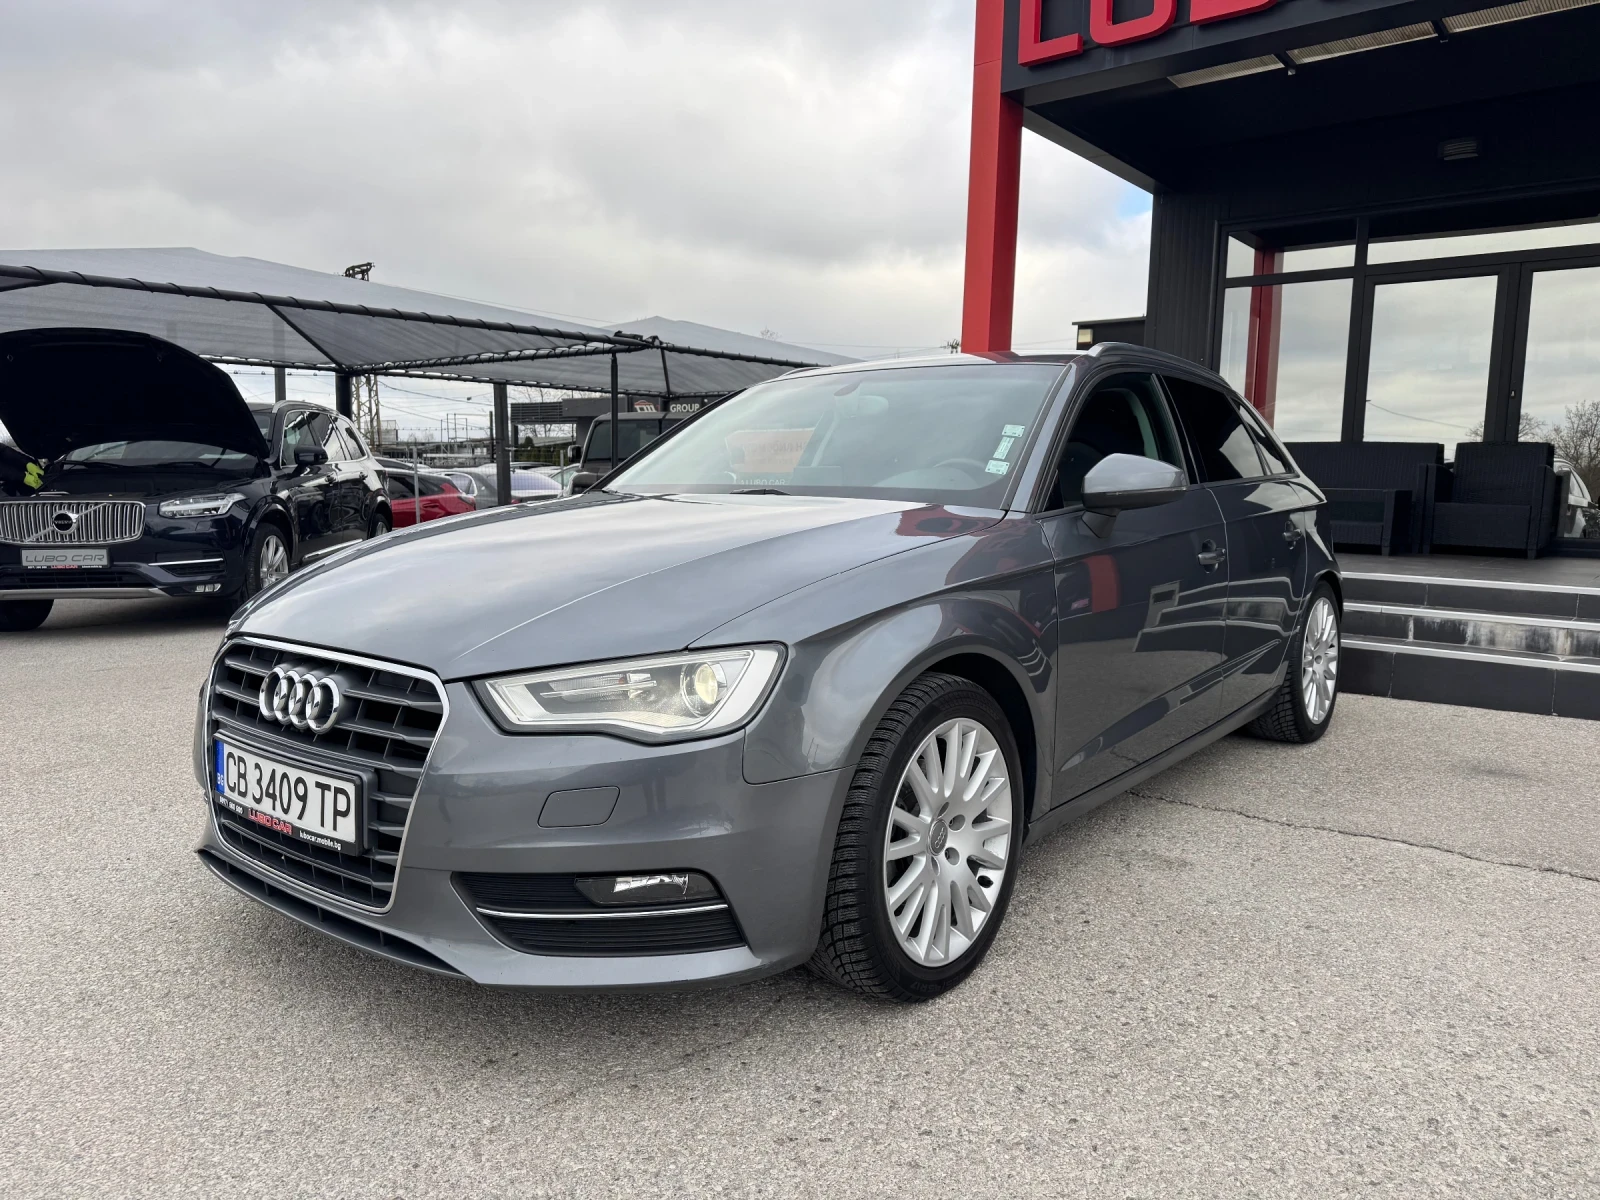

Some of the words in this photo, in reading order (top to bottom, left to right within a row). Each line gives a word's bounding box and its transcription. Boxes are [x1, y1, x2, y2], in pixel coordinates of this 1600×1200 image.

[670, 403, 700, 413] GROUP
[25, 555, 68, 563] LUBO
[71, 554, 105, 562] CAR
[216, 772, 224, 786] BG
[226, 751, 248, 798] CB
[252, 762, 309, 820] 3409
[315, 781, 351, 832] TP
[248, 808, 272, 828] LUBO
[272, 818, 293, 836] CAR
